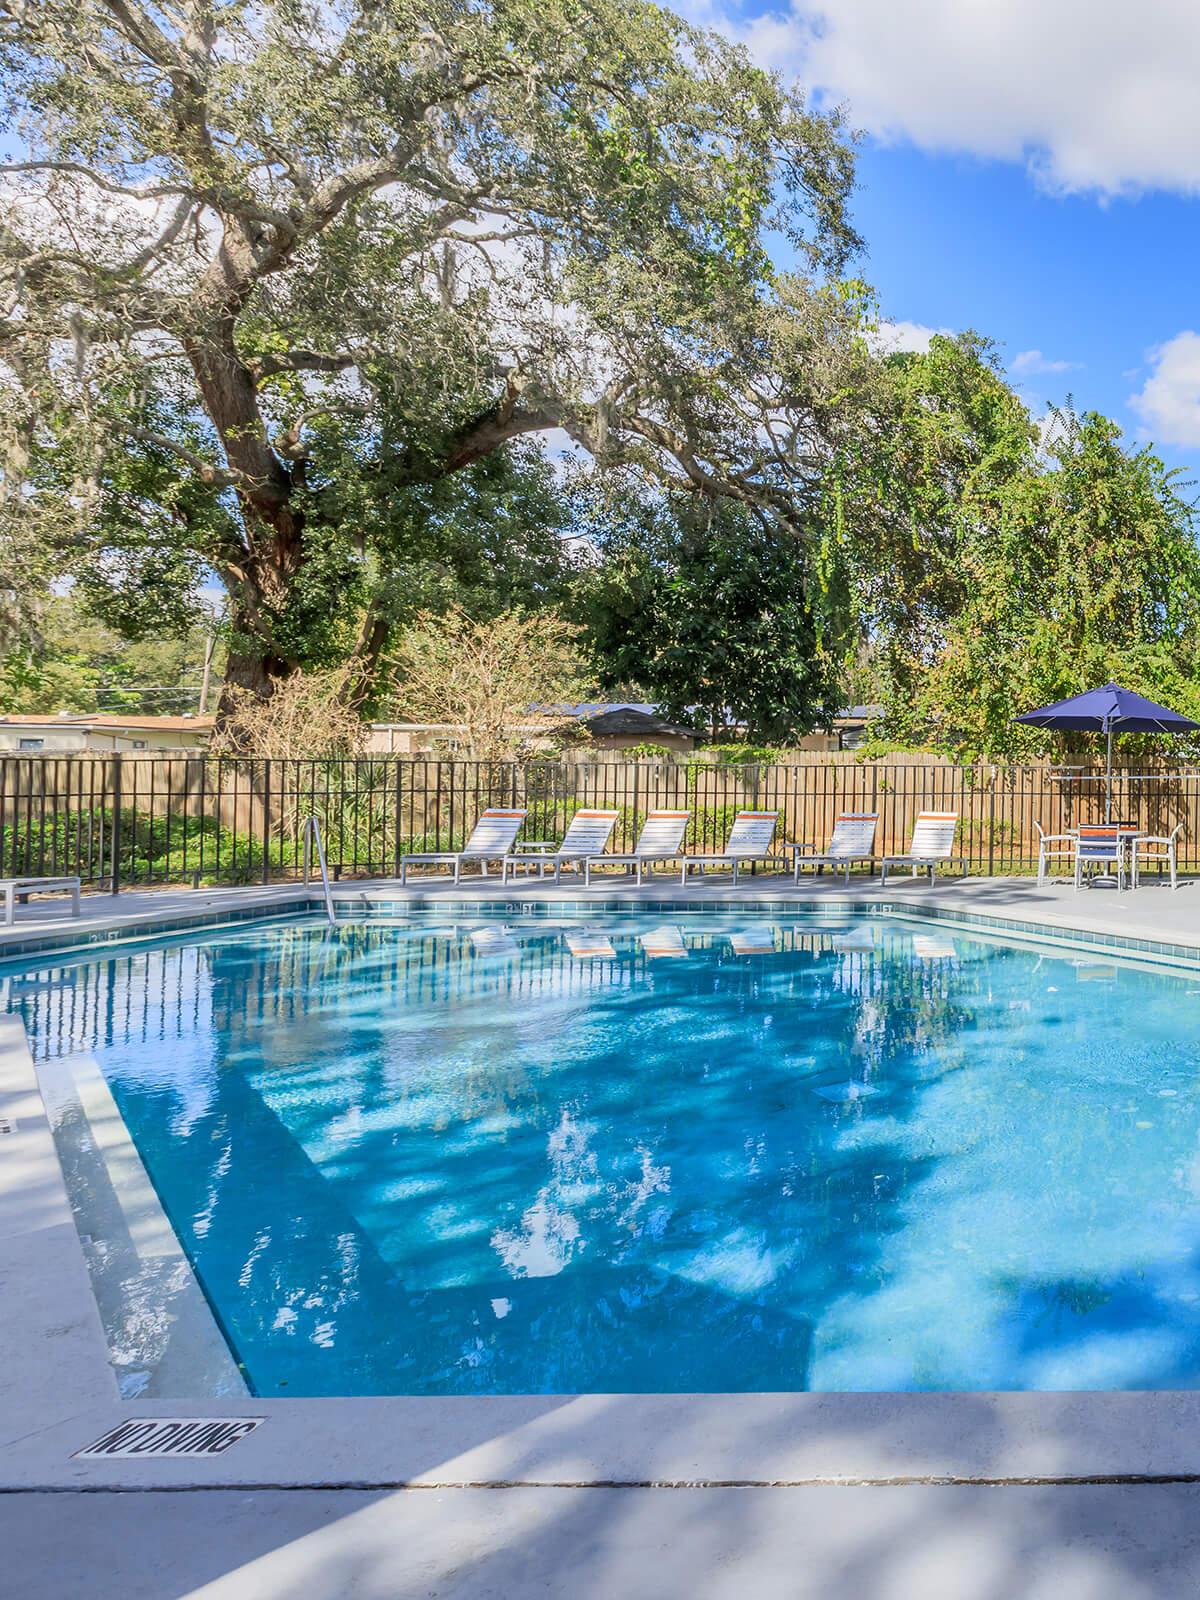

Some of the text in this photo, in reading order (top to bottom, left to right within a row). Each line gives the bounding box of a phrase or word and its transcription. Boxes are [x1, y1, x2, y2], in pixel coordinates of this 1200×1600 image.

[882, 904, 893, 914] FT
[84, 1422, 257, 1454] NO DIVING
